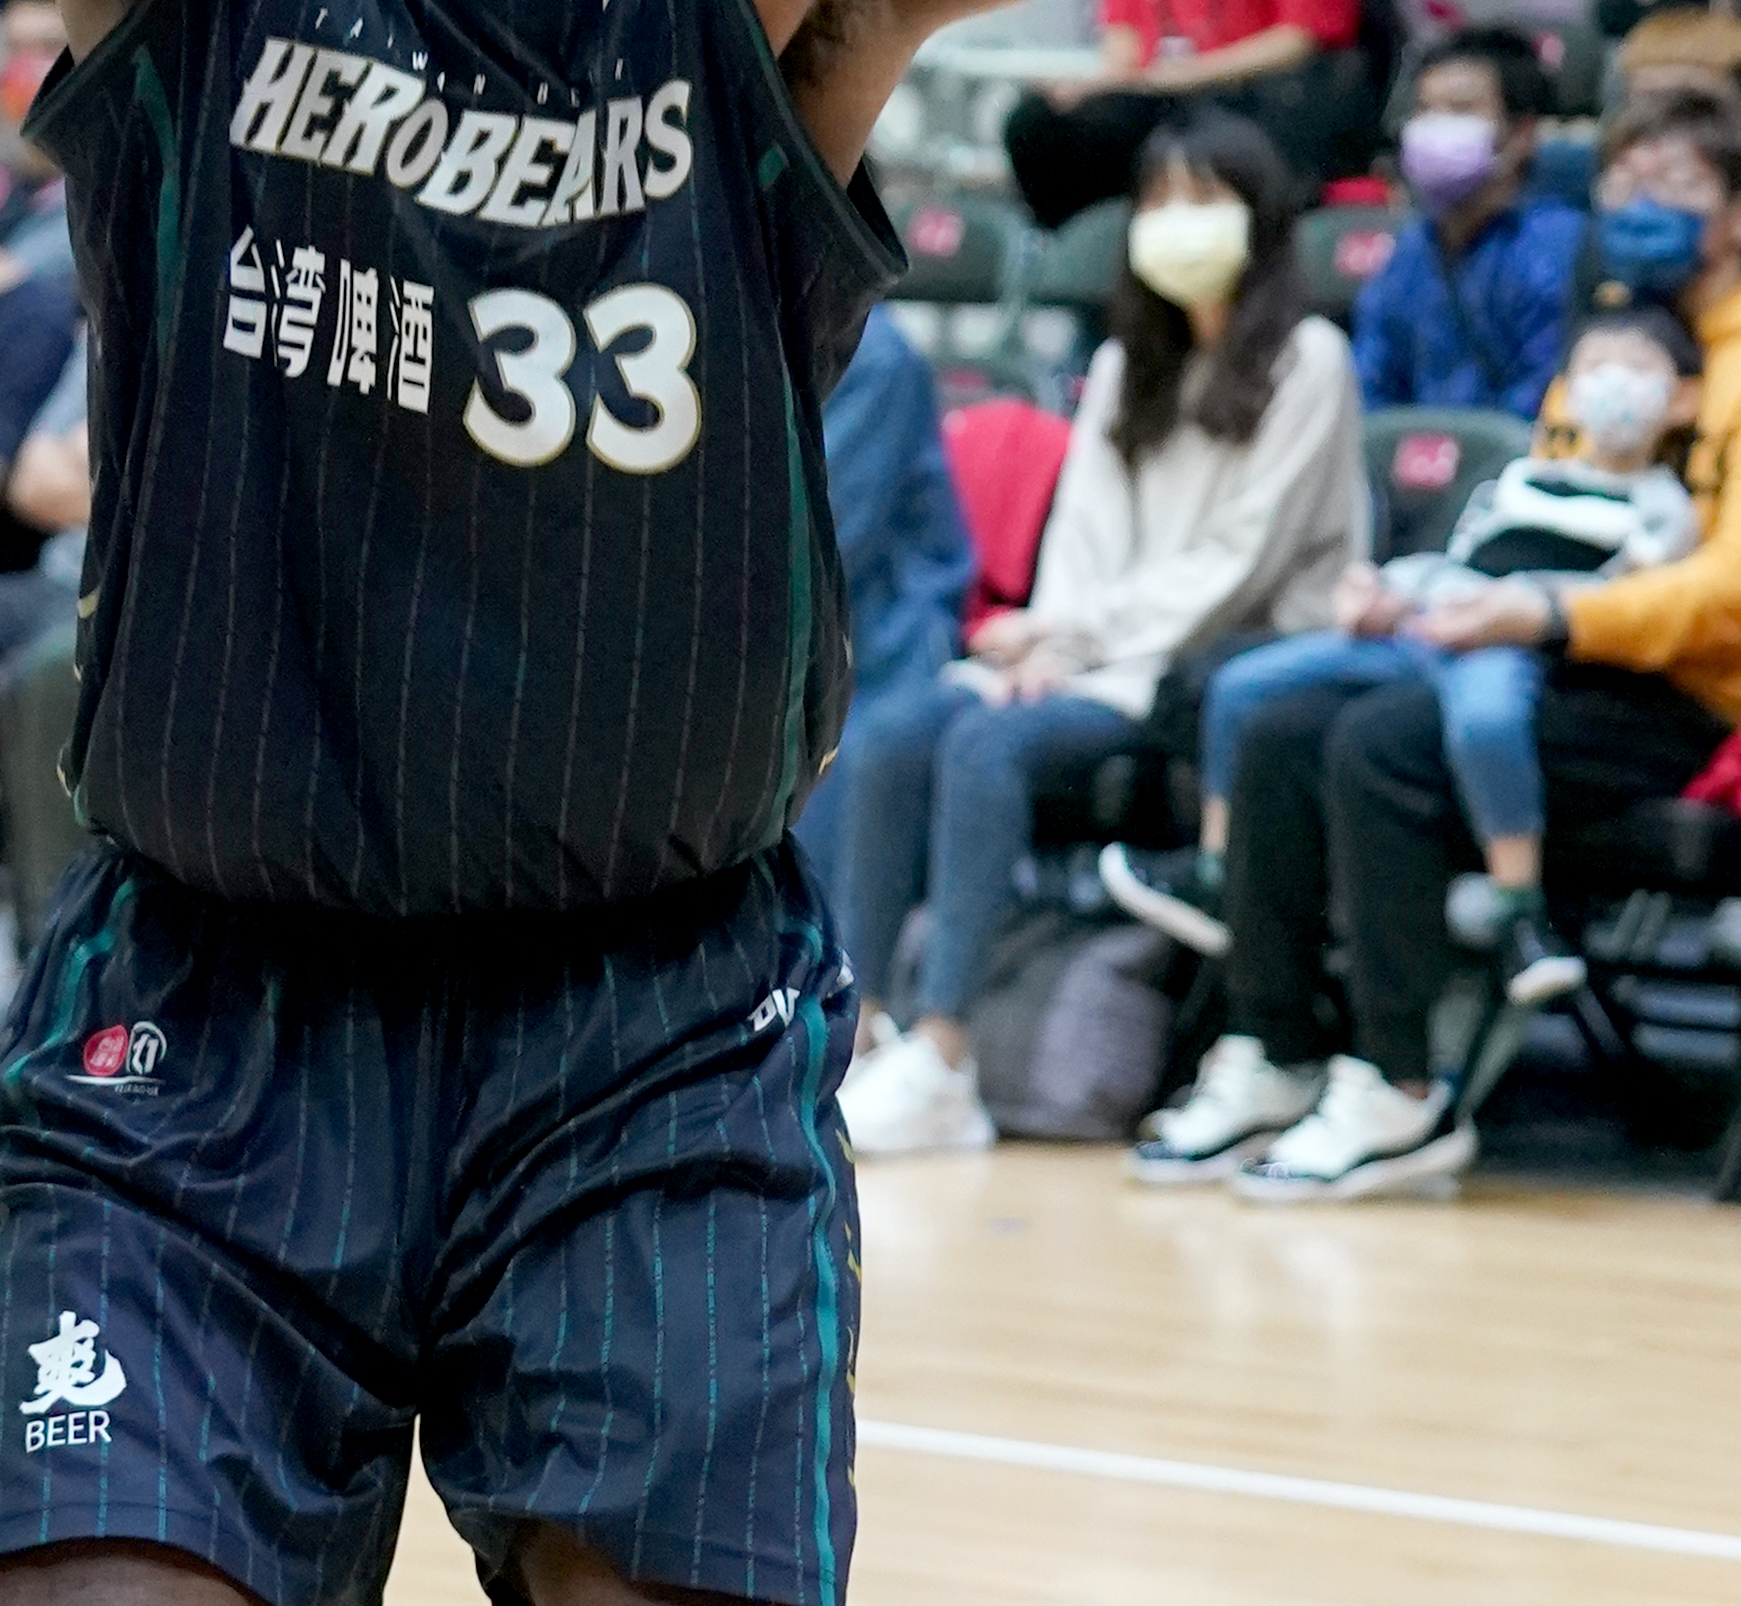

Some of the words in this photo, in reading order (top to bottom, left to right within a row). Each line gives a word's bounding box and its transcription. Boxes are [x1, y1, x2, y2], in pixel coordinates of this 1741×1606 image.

[228, 35, 693, 228] HEROBEARS
[222, 224, 435, 416] 台灣啤酒
[462, 281, 702, 476] 33
[24, 1409, 112, 1454] BEER
